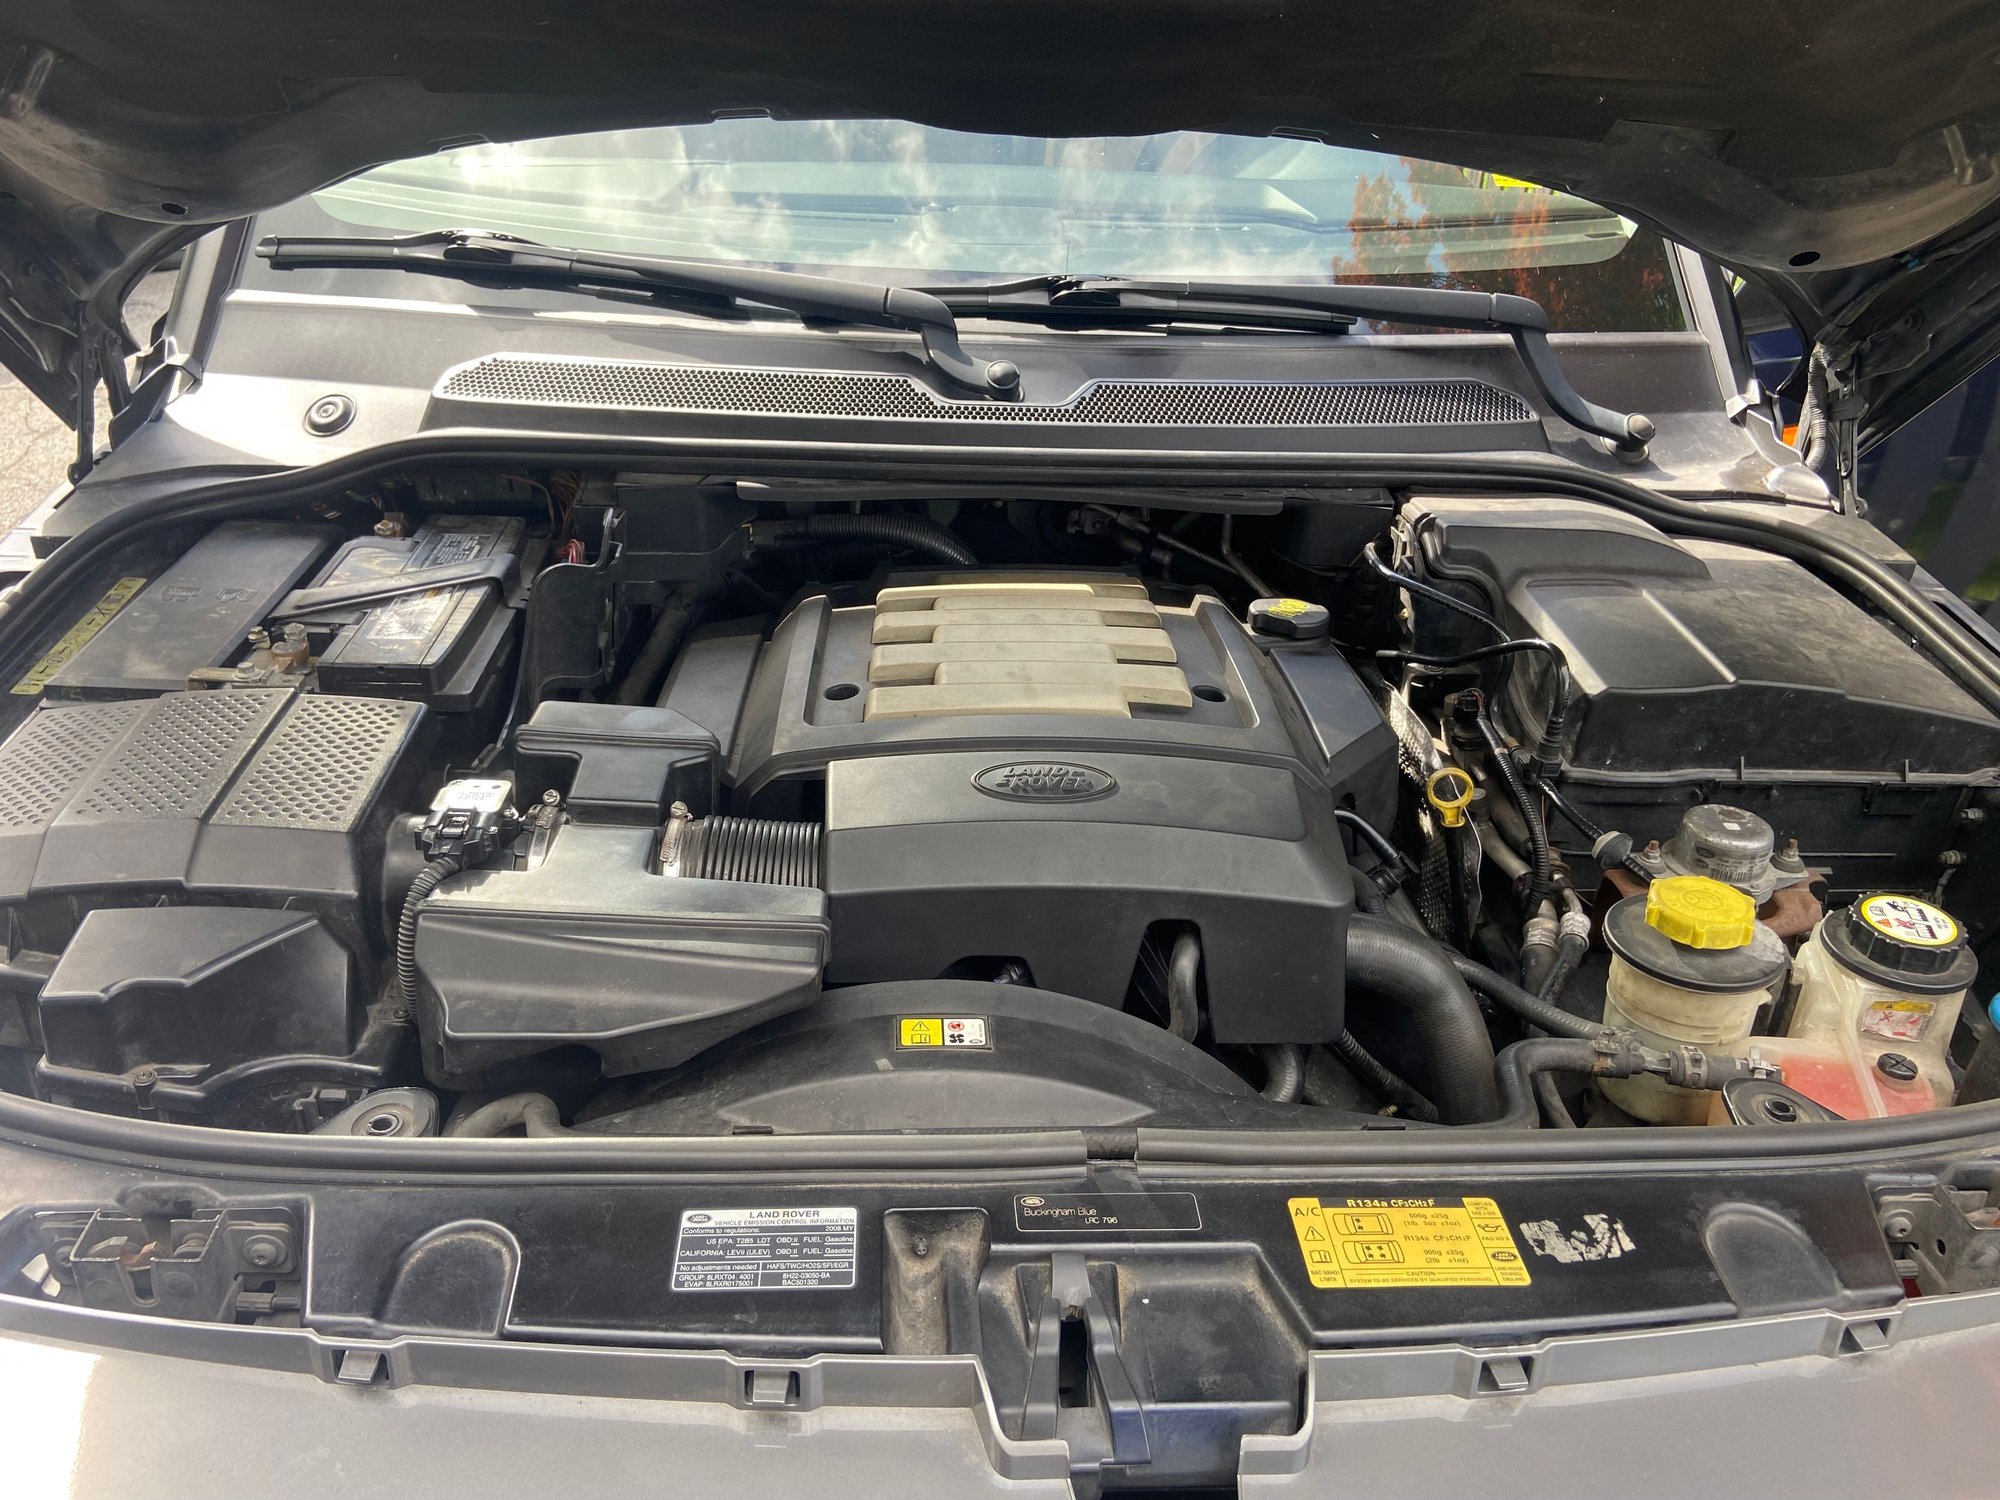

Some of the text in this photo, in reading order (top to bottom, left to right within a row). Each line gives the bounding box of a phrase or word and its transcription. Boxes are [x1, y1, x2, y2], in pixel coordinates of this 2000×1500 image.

[1003, 766, 1070, 777] LAND
[1009, 776, 1094, 793] ROVER
[1346, 1199, 1388, 1208] R134a
[749, 1210, 820, 1219] LAND ROVER
[1024, 1207, 1097, 1217] Buckingham Blue
[1294, 1207, 1321, 1217] A/C
[757, 1236, 771, 1244] LDT
[1403, 1234, 1430, 1242] R134a
[680, 1249, 726, 1257] CALIFORNIA:
[746, 1248, 771, 1256] (ULEV)
[691, 1264, 731, 1272] adjustments
